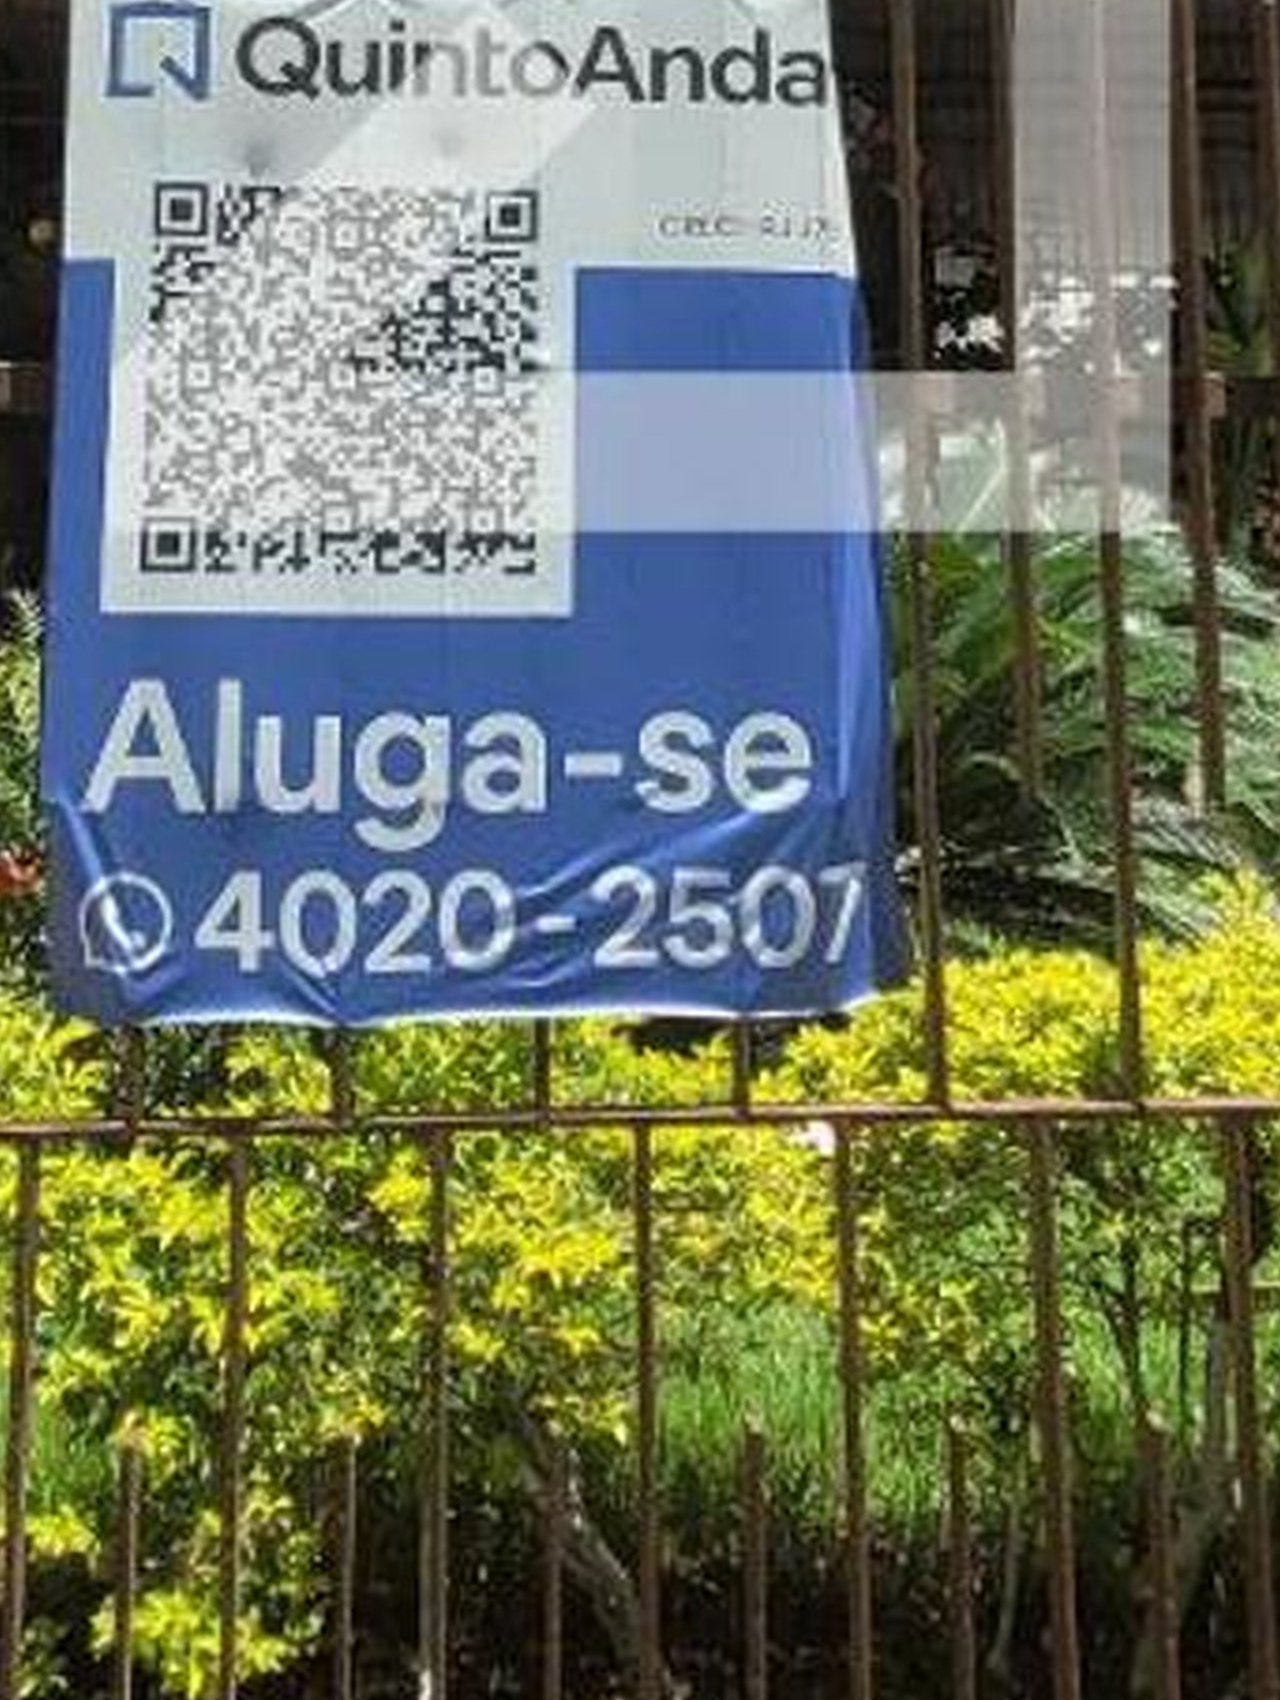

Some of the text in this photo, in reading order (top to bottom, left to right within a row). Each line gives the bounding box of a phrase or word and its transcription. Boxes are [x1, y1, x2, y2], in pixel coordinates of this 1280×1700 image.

[235, 15, 827, 108] QuintoAnda
[83, 679, 813, 852] Aluga-se
[194, 863, 867, 974] 4020-2507
